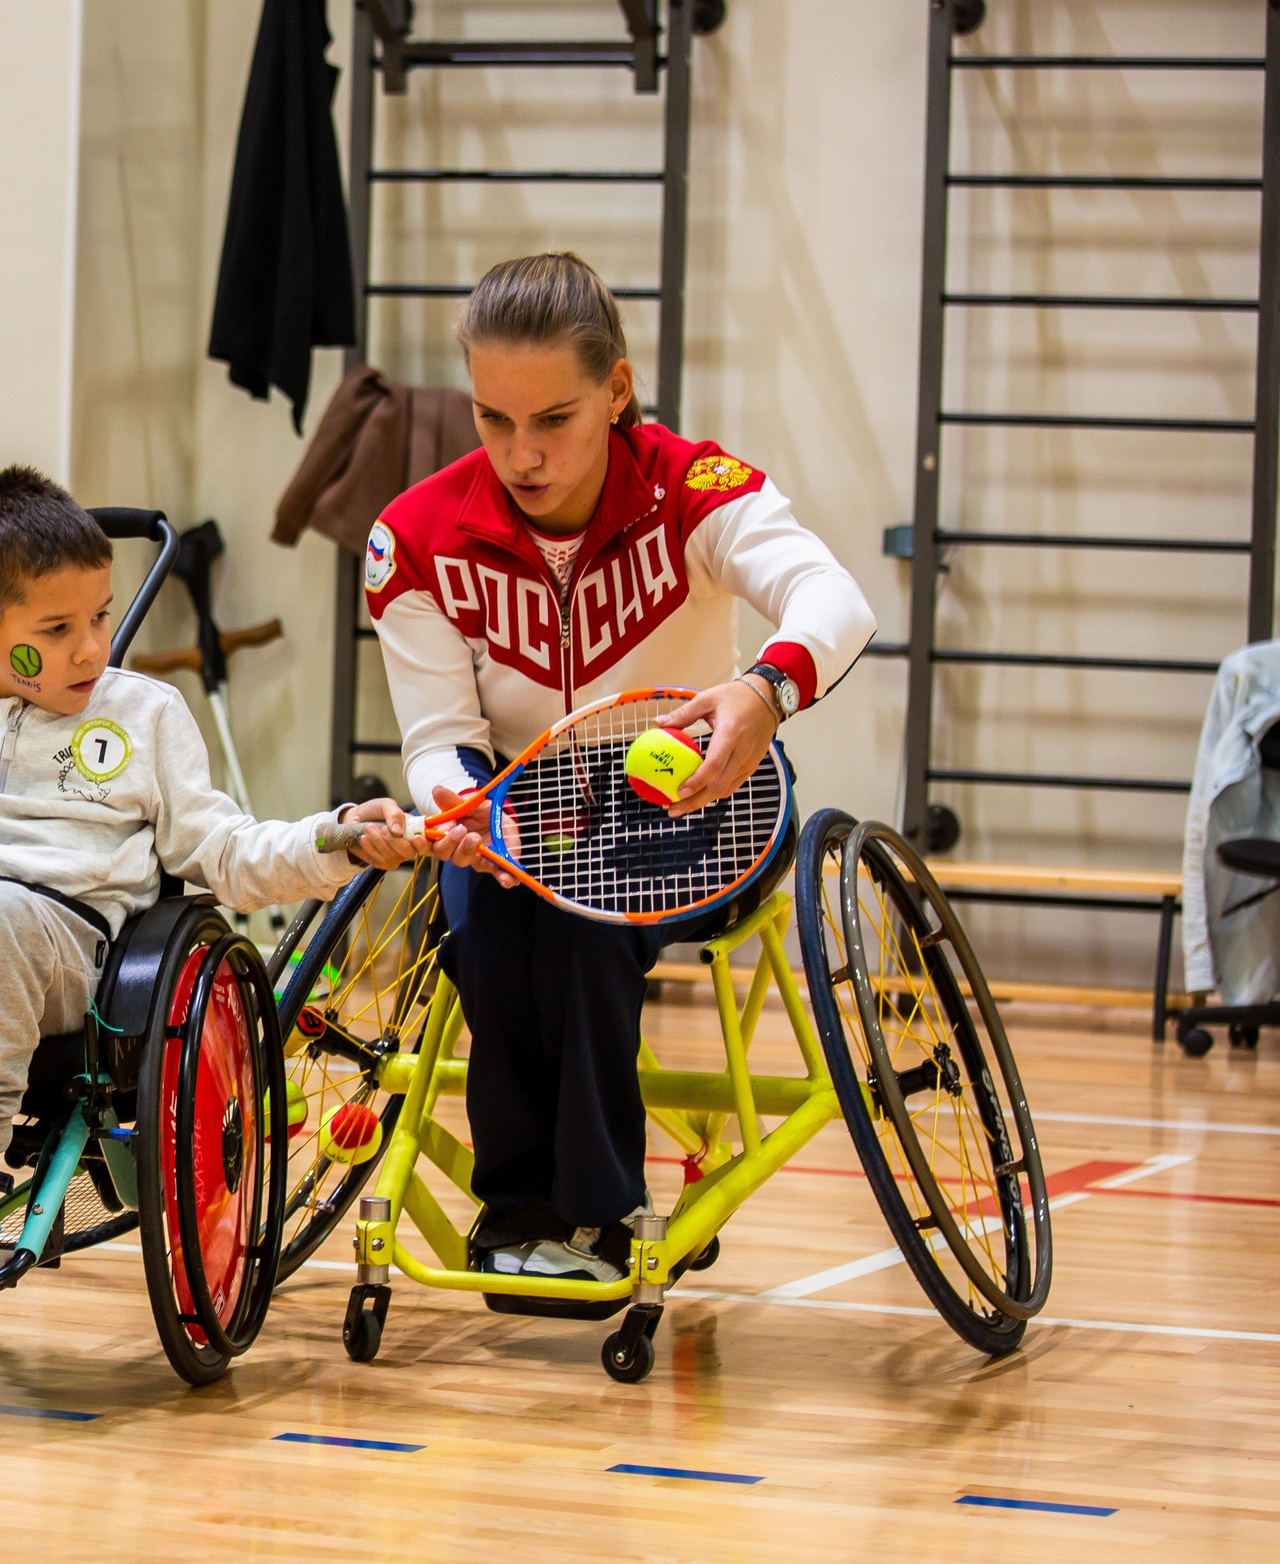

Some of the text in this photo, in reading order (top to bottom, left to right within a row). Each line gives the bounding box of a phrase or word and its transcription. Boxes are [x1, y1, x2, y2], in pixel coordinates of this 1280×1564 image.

[433, 523, 677, 671] РОССИЯ
[94, 738, 108, 764] 7
[650, 751, 671, 767] TENNIS
[660, 750, 674, 762] LIFE
[981, 1068, 1022, 1219] SPINEGY
